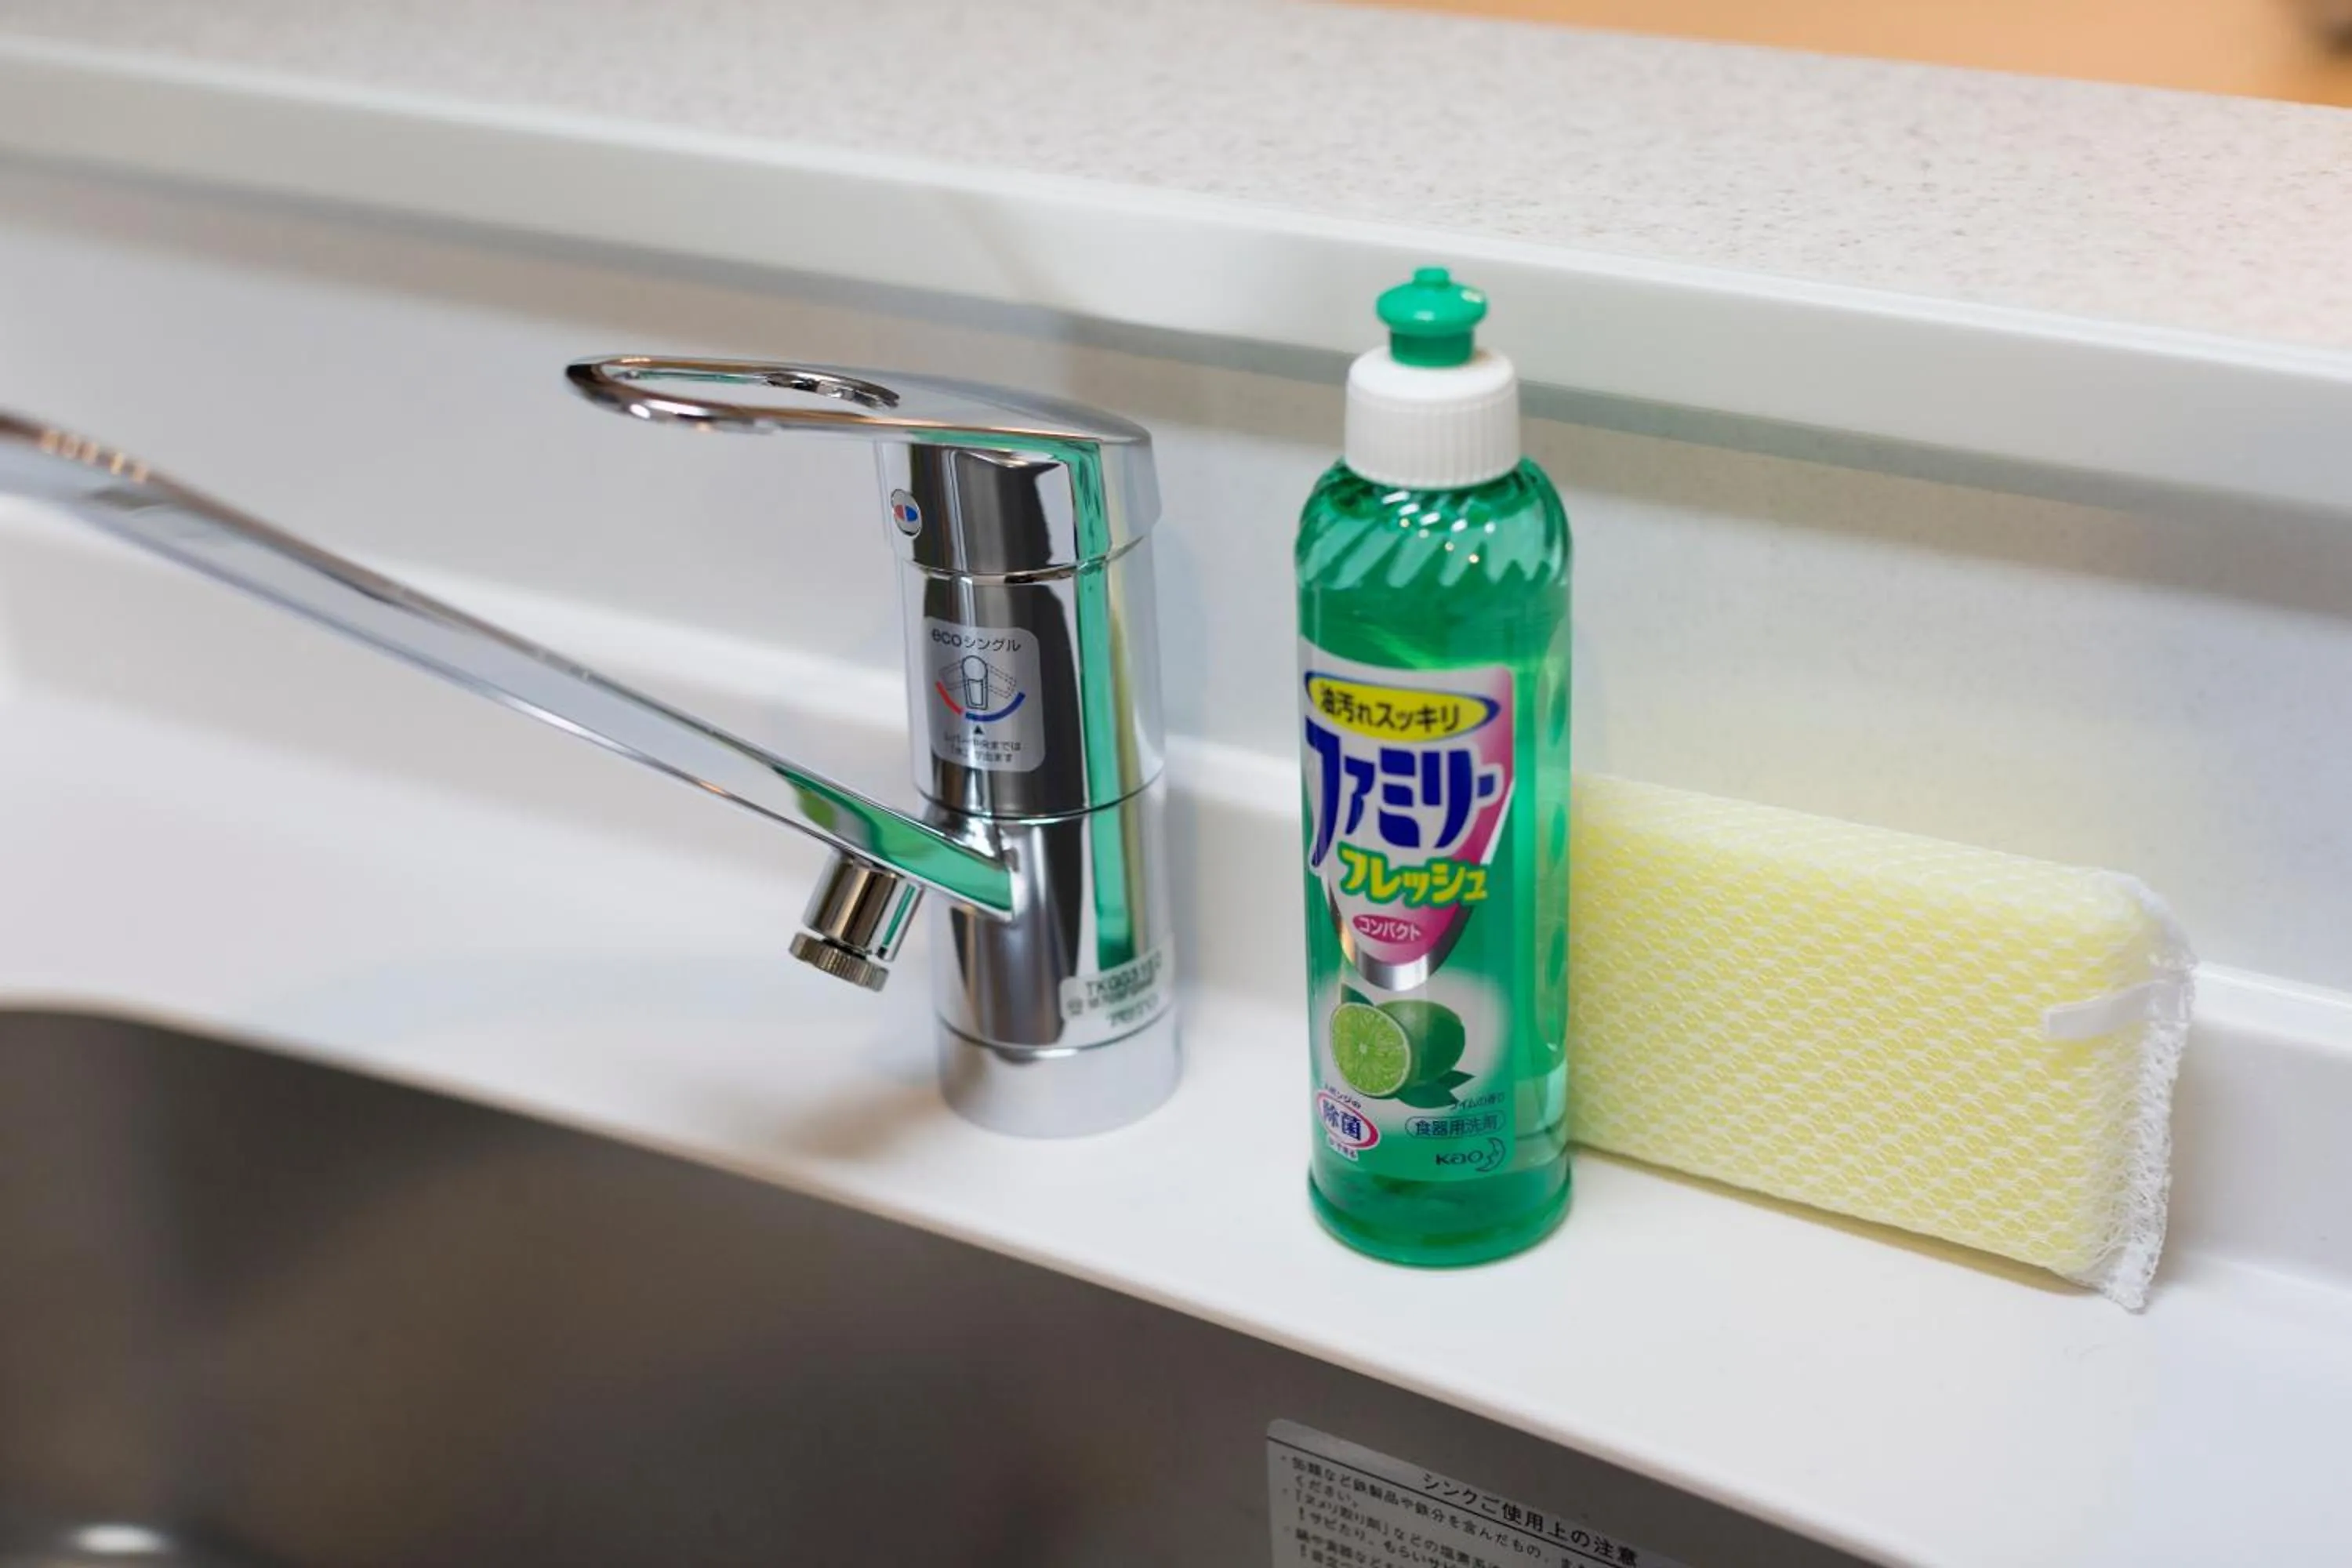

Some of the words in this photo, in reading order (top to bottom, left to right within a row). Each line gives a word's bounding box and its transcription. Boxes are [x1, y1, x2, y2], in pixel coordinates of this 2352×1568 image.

[1320, 682, 1461, 733] 油汚れスッキリ
[1305, 715, 1495, 867] ファミリー
[1338, 843, 1488, 906] フレッシュ
[1357, 916, 1421, 941] コンパクト
[1322, 1098, 1362, 1142] 除菌
[1415, 1114, 1499, 1137] 食器用洗剤
[1422, 1472, 1638, 1568] シンクご使用上の注意
